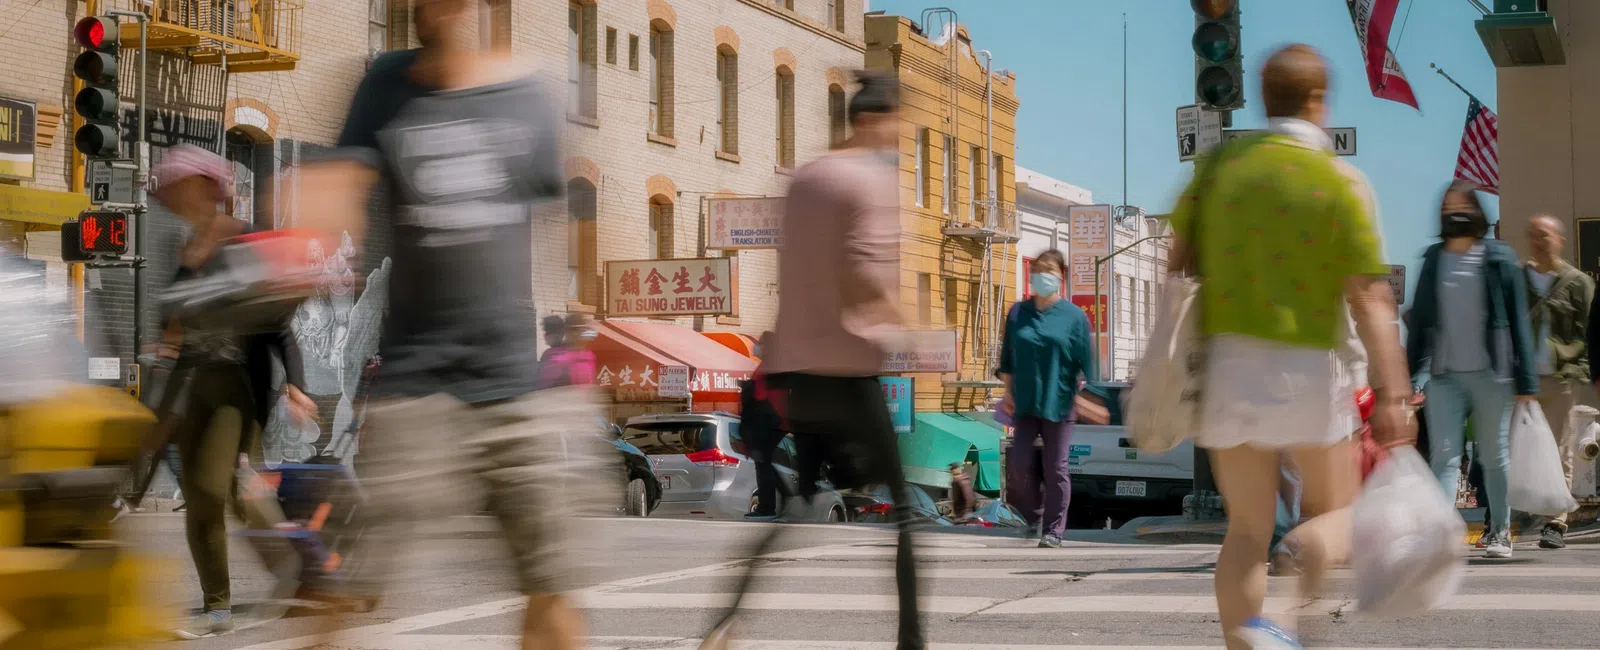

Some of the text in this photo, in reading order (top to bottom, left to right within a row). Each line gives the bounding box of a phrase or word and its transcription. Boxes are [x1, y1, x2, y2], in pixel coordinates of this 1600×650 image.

[109, 219, 125, 245] 12
[731, 237, 772, 245] TRANSLATION
[615, 296, 726, 313] TAI SUNG JEWELRY
[910, 351, 952, 361] COMPANY
[659, 366, 668, 375] NO
[713, 372, 724, 389] Tai
